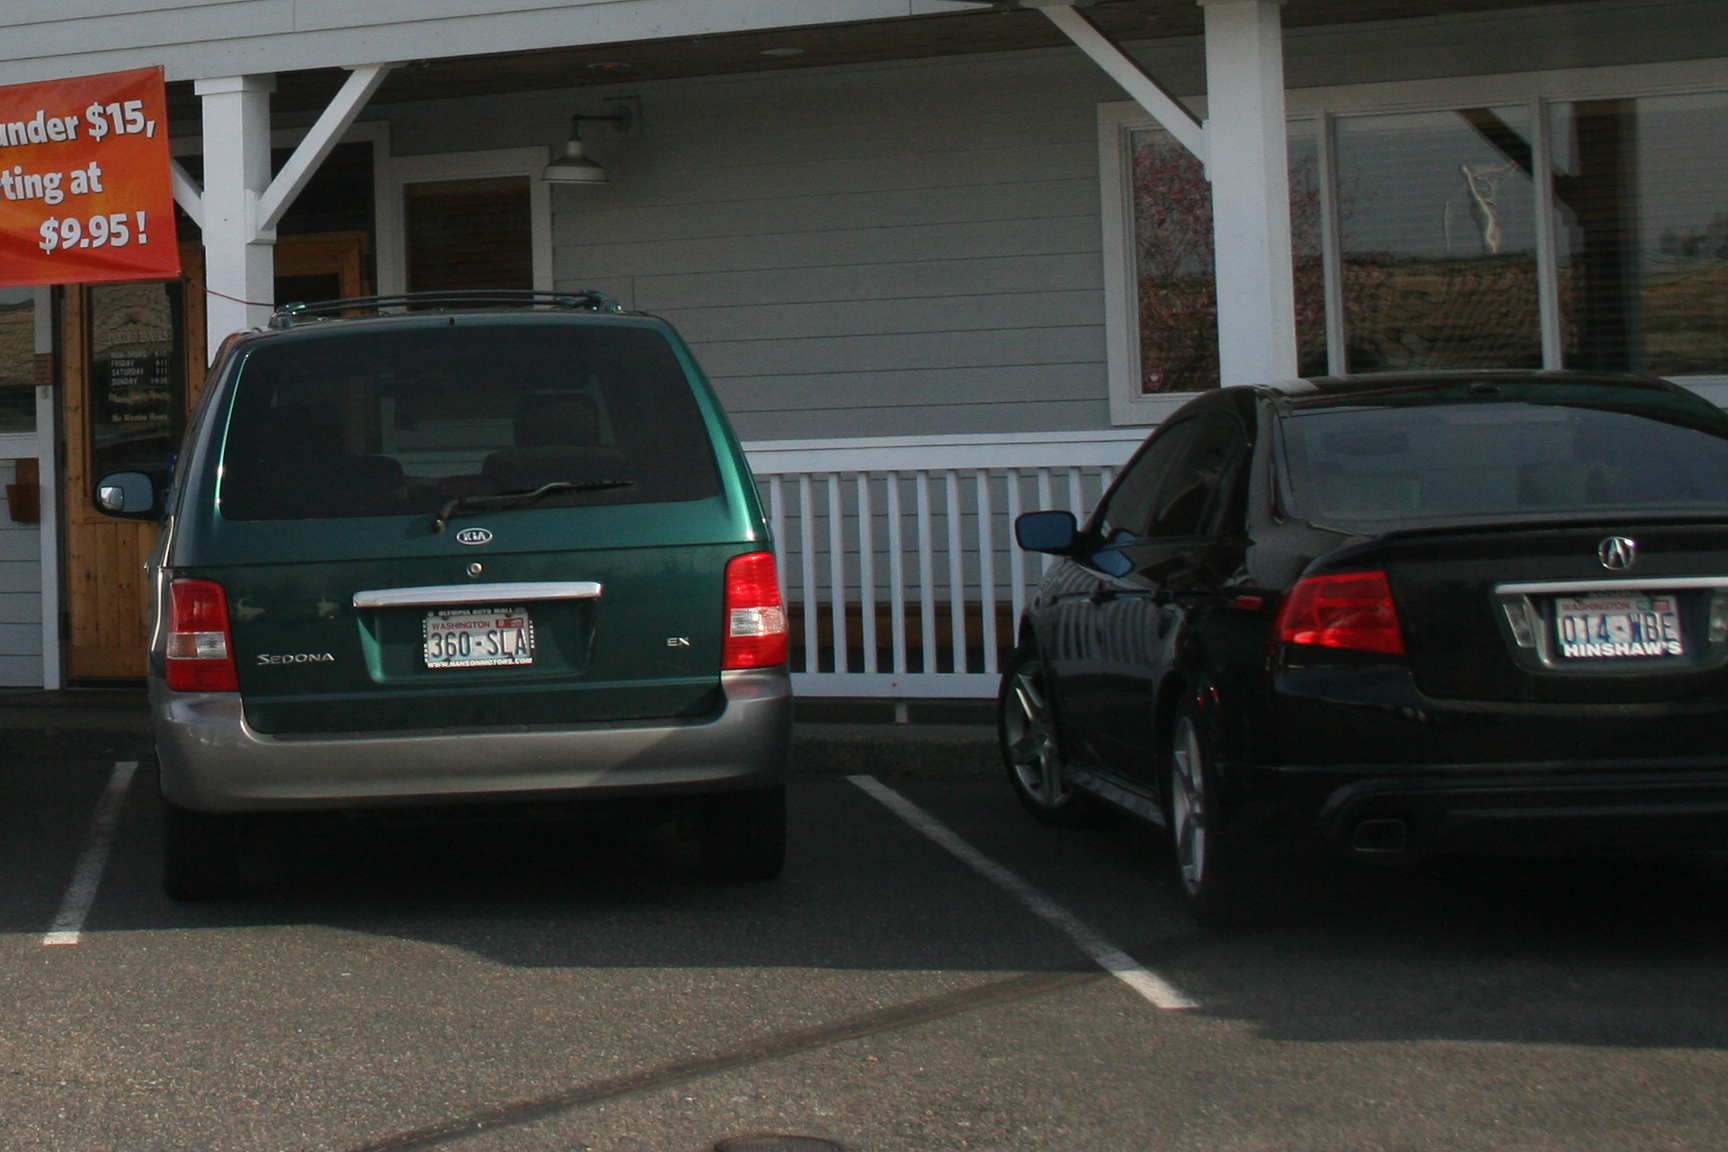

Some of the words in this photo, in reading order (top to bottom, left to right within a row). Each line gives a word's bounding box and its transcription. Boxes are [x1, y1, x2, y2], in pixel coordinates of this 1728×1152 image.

[86, 100, 155, 142] $15,
[70, 161, 103, 195] at
[39, 213, 129, 255] $9.95
[111, 359, 135, 367] FRIDAY
[112, 368, 144, 376] SATURDAY
[112, 377, 138, 386] SUNDAY
[462, 531, 486, 541] KIA
[432, 620, 490, 630] WASHINGTON
[667, 637, 690, 647] EX
[1563, 641, 1684, 658] HINSHAW'S
[257, 652, 335, 666] SEDONA
